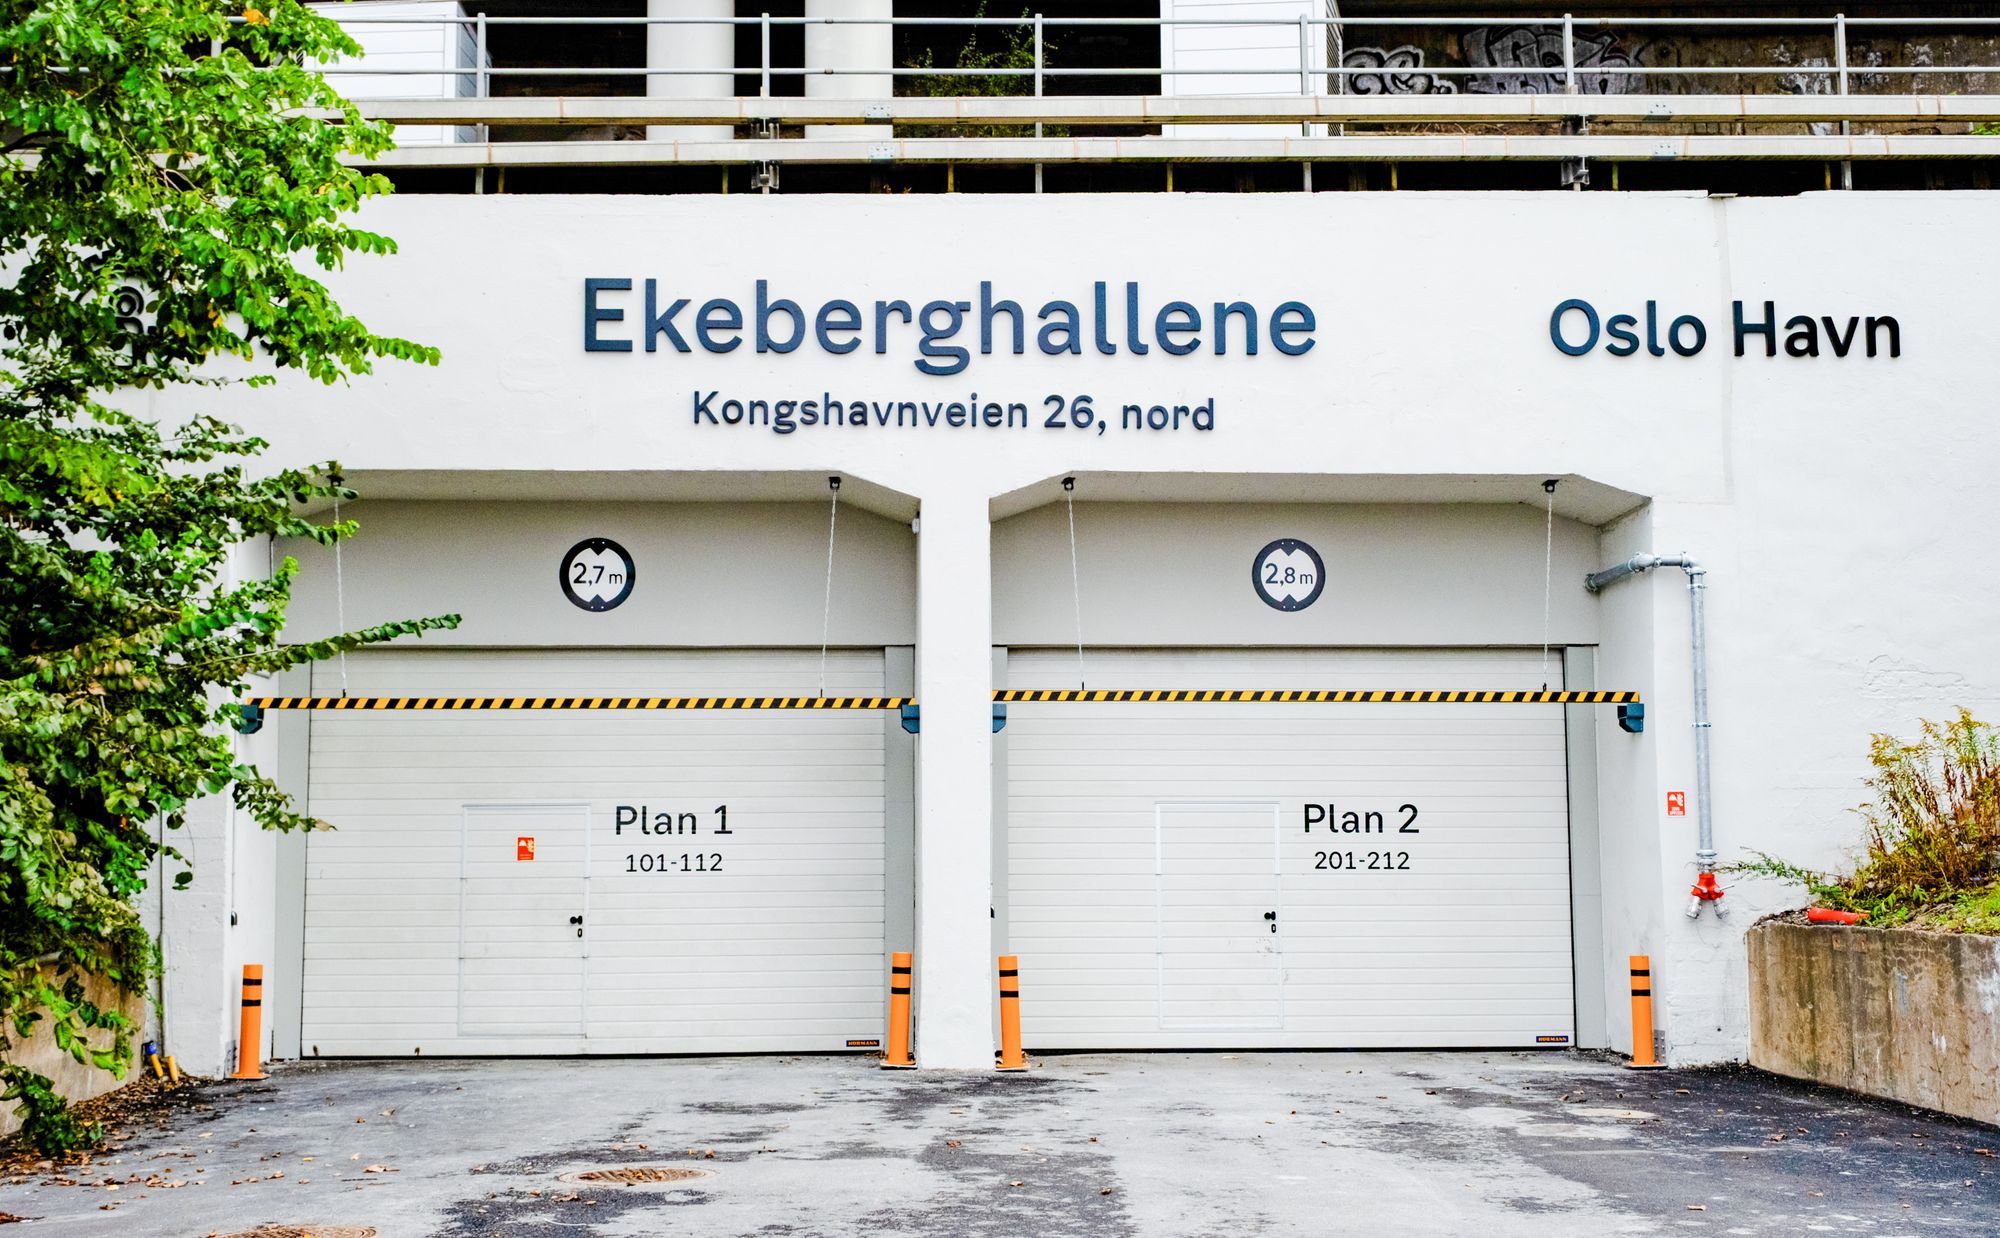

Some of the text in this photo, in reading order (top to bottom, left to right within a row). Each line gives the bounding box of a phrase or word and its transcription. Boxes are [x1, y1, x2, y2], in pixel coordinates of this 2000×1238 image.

[584, 277, 1316, 377] Ekeberghallene
[1549, 298, 1901, 359] Oslo Havn
[693, 390, 1214, 436] Kongshavnveien 26, nord
[573, 562, 623, 586] 2,7 m
[1265, 562, 1313, 586] 2,8 m
[615, 804, 733, 836] Plan 1
[1304, 803, 1420, 834] Plan 2
[626, 852, 723, 873] 101-112
[1314, 851, 1410, 870] 201-212
